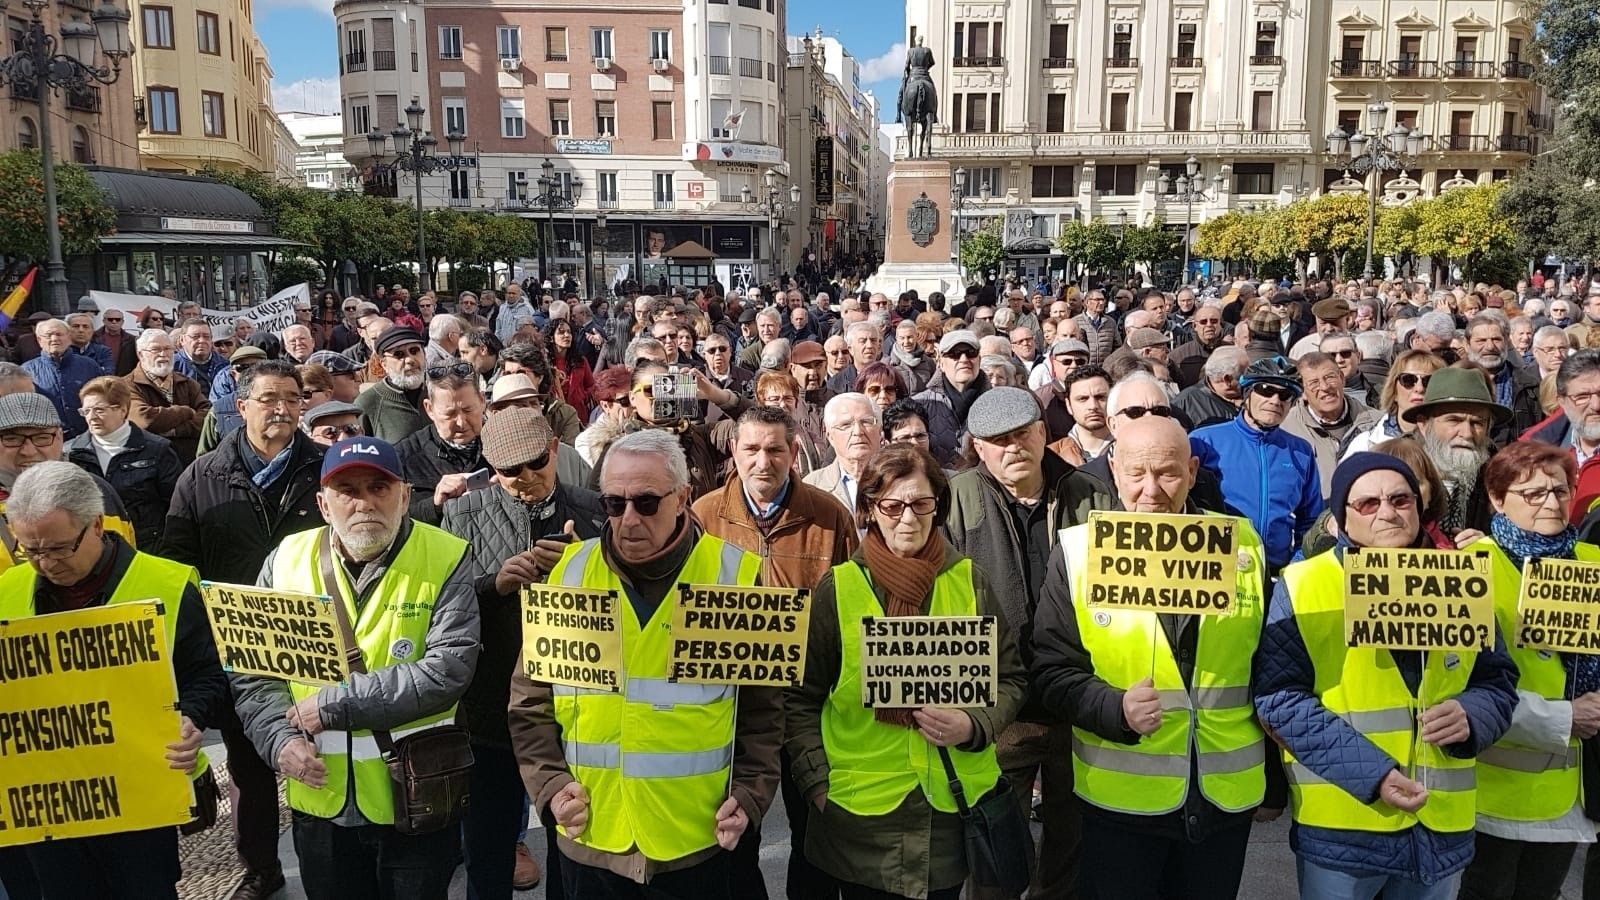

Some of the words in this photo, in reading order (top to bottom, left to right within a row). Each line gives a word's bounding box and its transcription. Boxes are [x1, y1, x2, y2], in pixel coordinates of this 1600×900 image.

[440, 158, 474, 167] OTEL
[341, 443, 380, 457] FILA
[1095, 520, 1232, 554] PERDÓN
[1101, 556, 1146, 577] POR
[1162, 559, 1222, 581] VIVIR
[1366, 553, 1388, 568] MI
[1398, 553, 1474, 570] FAMILIA
[1092, 584, 1230, 609] DEMASIADO
[1350, 574, 1389, 595] EN
[1405, 575, 1488, 598] PARO
[219, 589, 237, 607] DE
[241, 593, 316, 617] NUESTRAS
[528, 590, 611, 614] RECORTE
[680, 590, 804, 612] PENSIONES
[1368, 599, 1437, 619] ¿CÓMO
[1447, 604, 1470, 619] LA
[212, 607, 334, 638] PENSIONES
[526, 610, 540, 624] DE
[546, 612, 614, 632] PENSIONES
[685, 611, 796, 632] PRIVADAS
[866, 621, 990, 636] ESTUDIANTE
[1523, 608, 1591, 629] HAMBRE
[56, 619, 160, 672] GOBIERNE
[217, 627, 266, 646] VIVEN
[274, 634, 338, 656] MUCHOS
[1352, 621, 1488, 647] MANTENGO?
[536, 637, 601, 663] OFICIO
[674, 640, 800, 662] PERSONAS
[866, 641, 990, 656] TRABAJADOR
[225, 645, 344, 682] MILLONES
[528, 660, 542, 676] DE
[549, 663, 616, 685] LADRONES
[673, 662, 798, 681] ESTAFADAS
[867, 665, 951, 677] LUCHAMOS
[959, 665, 991, 677] POR
[867, 681, 891, 704] TU
[902, 678, 990, 704] PENSIÓN
[0, 700, 115, 756] PENSIONES
[8, 776, 121, 829] DEFIENDEN
